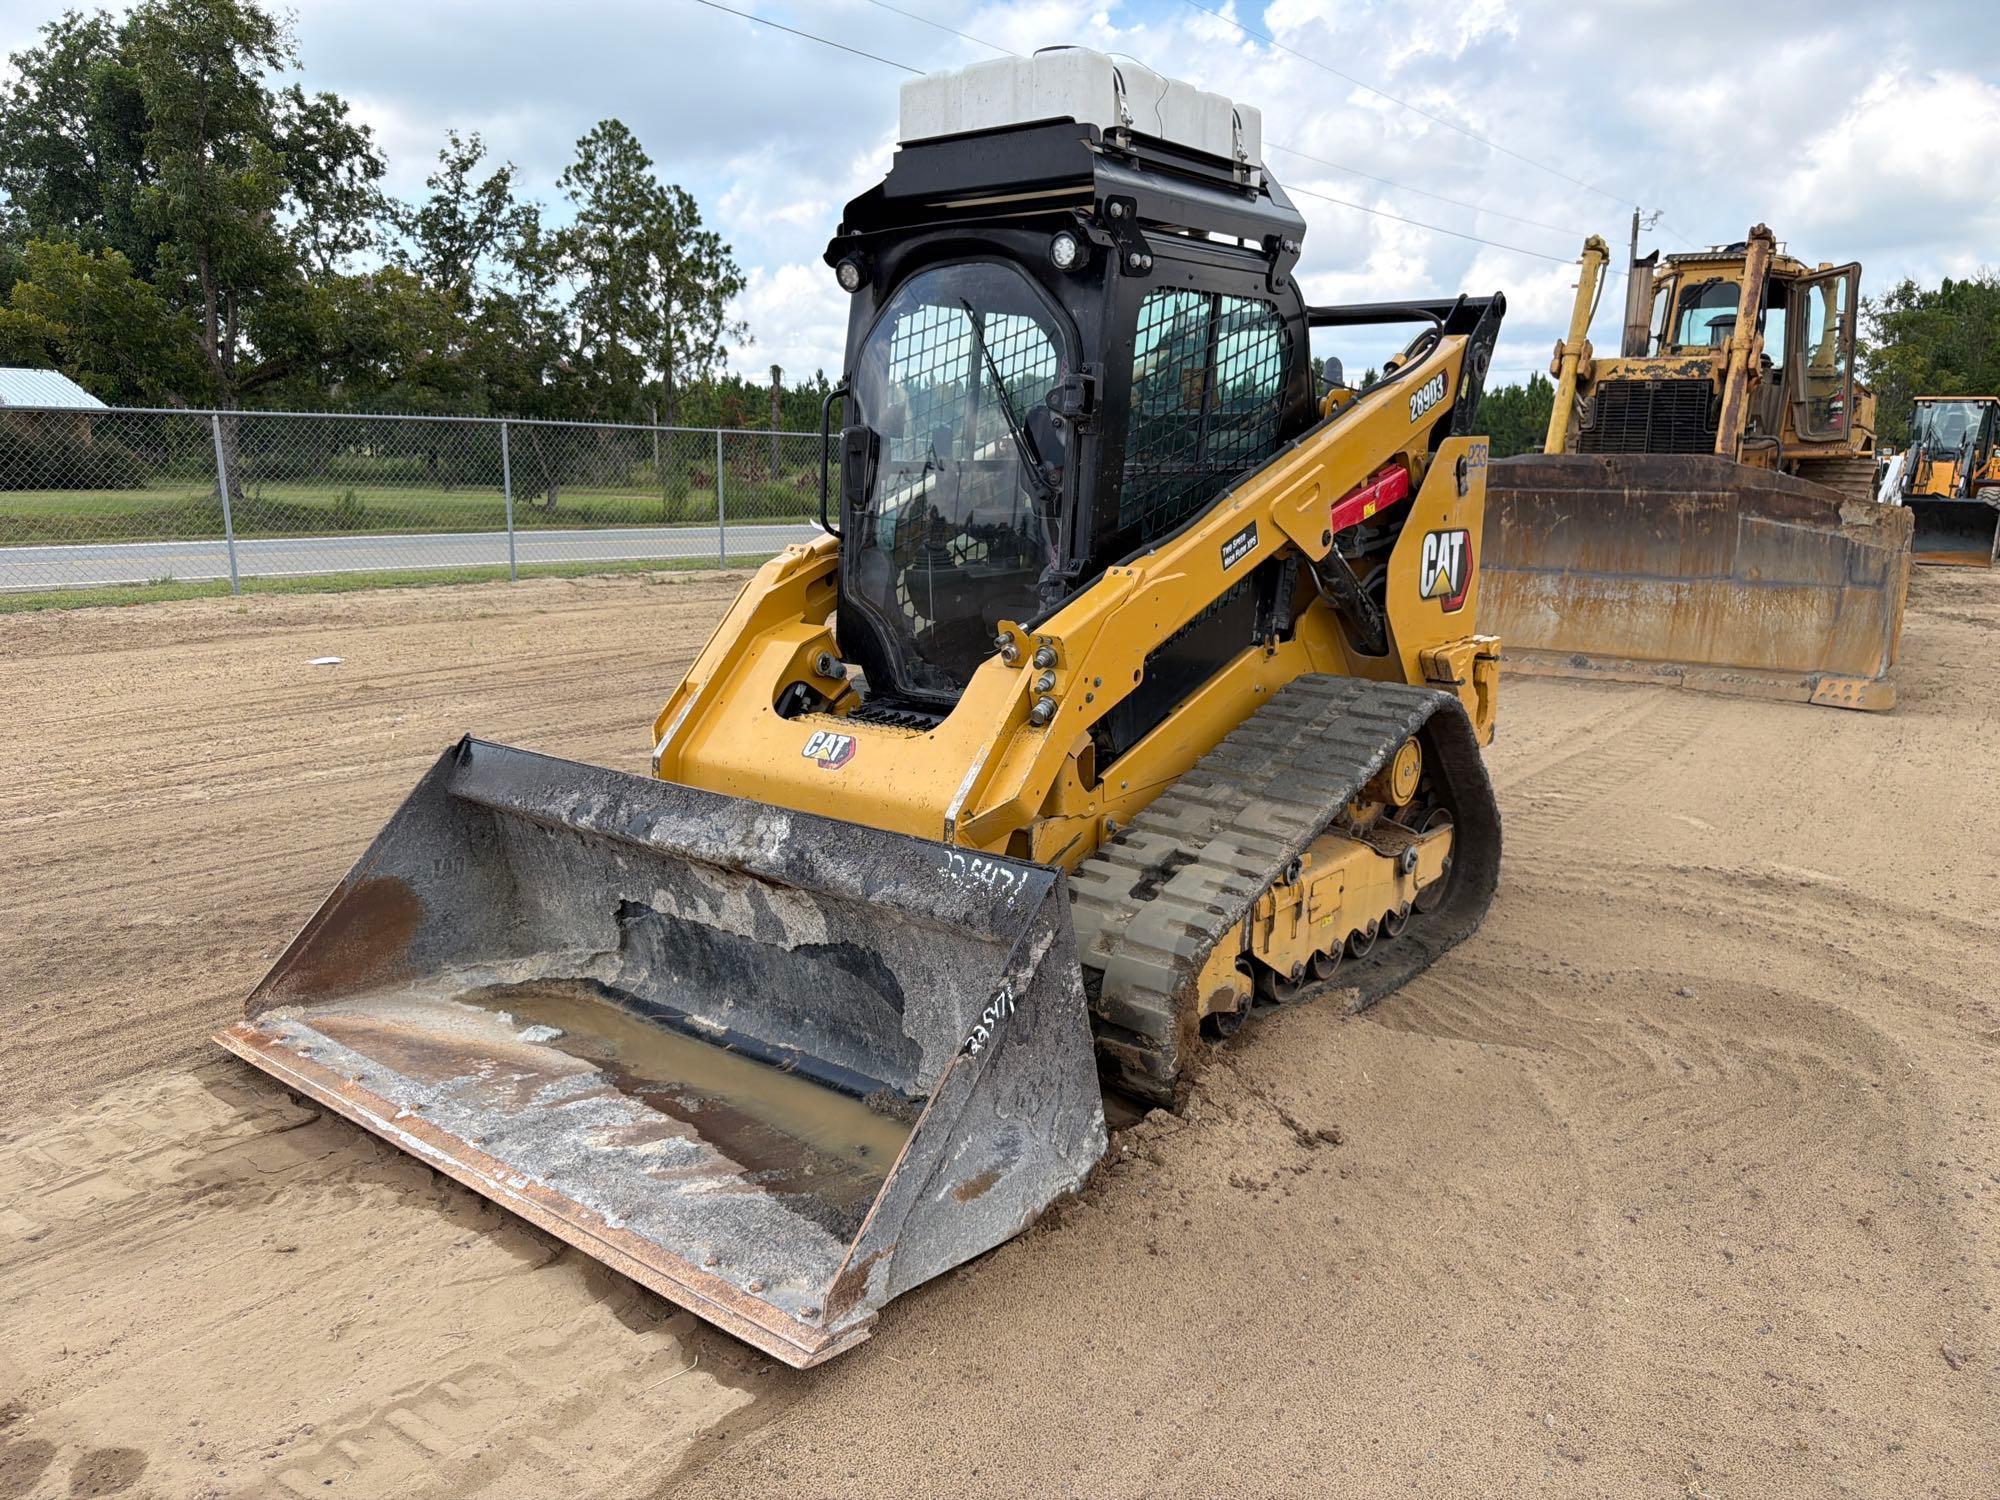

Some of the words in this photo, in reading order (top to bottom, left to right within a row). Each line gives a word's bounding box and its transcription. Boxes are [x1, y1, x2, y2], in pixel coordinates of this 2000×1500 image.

[1409, 373, 1445, 422] 289D3
[1420, 532, 1464, 598] CAT
[803, 731, 851, 761] CAT
[964, 982, 1015, 1055] 225471
